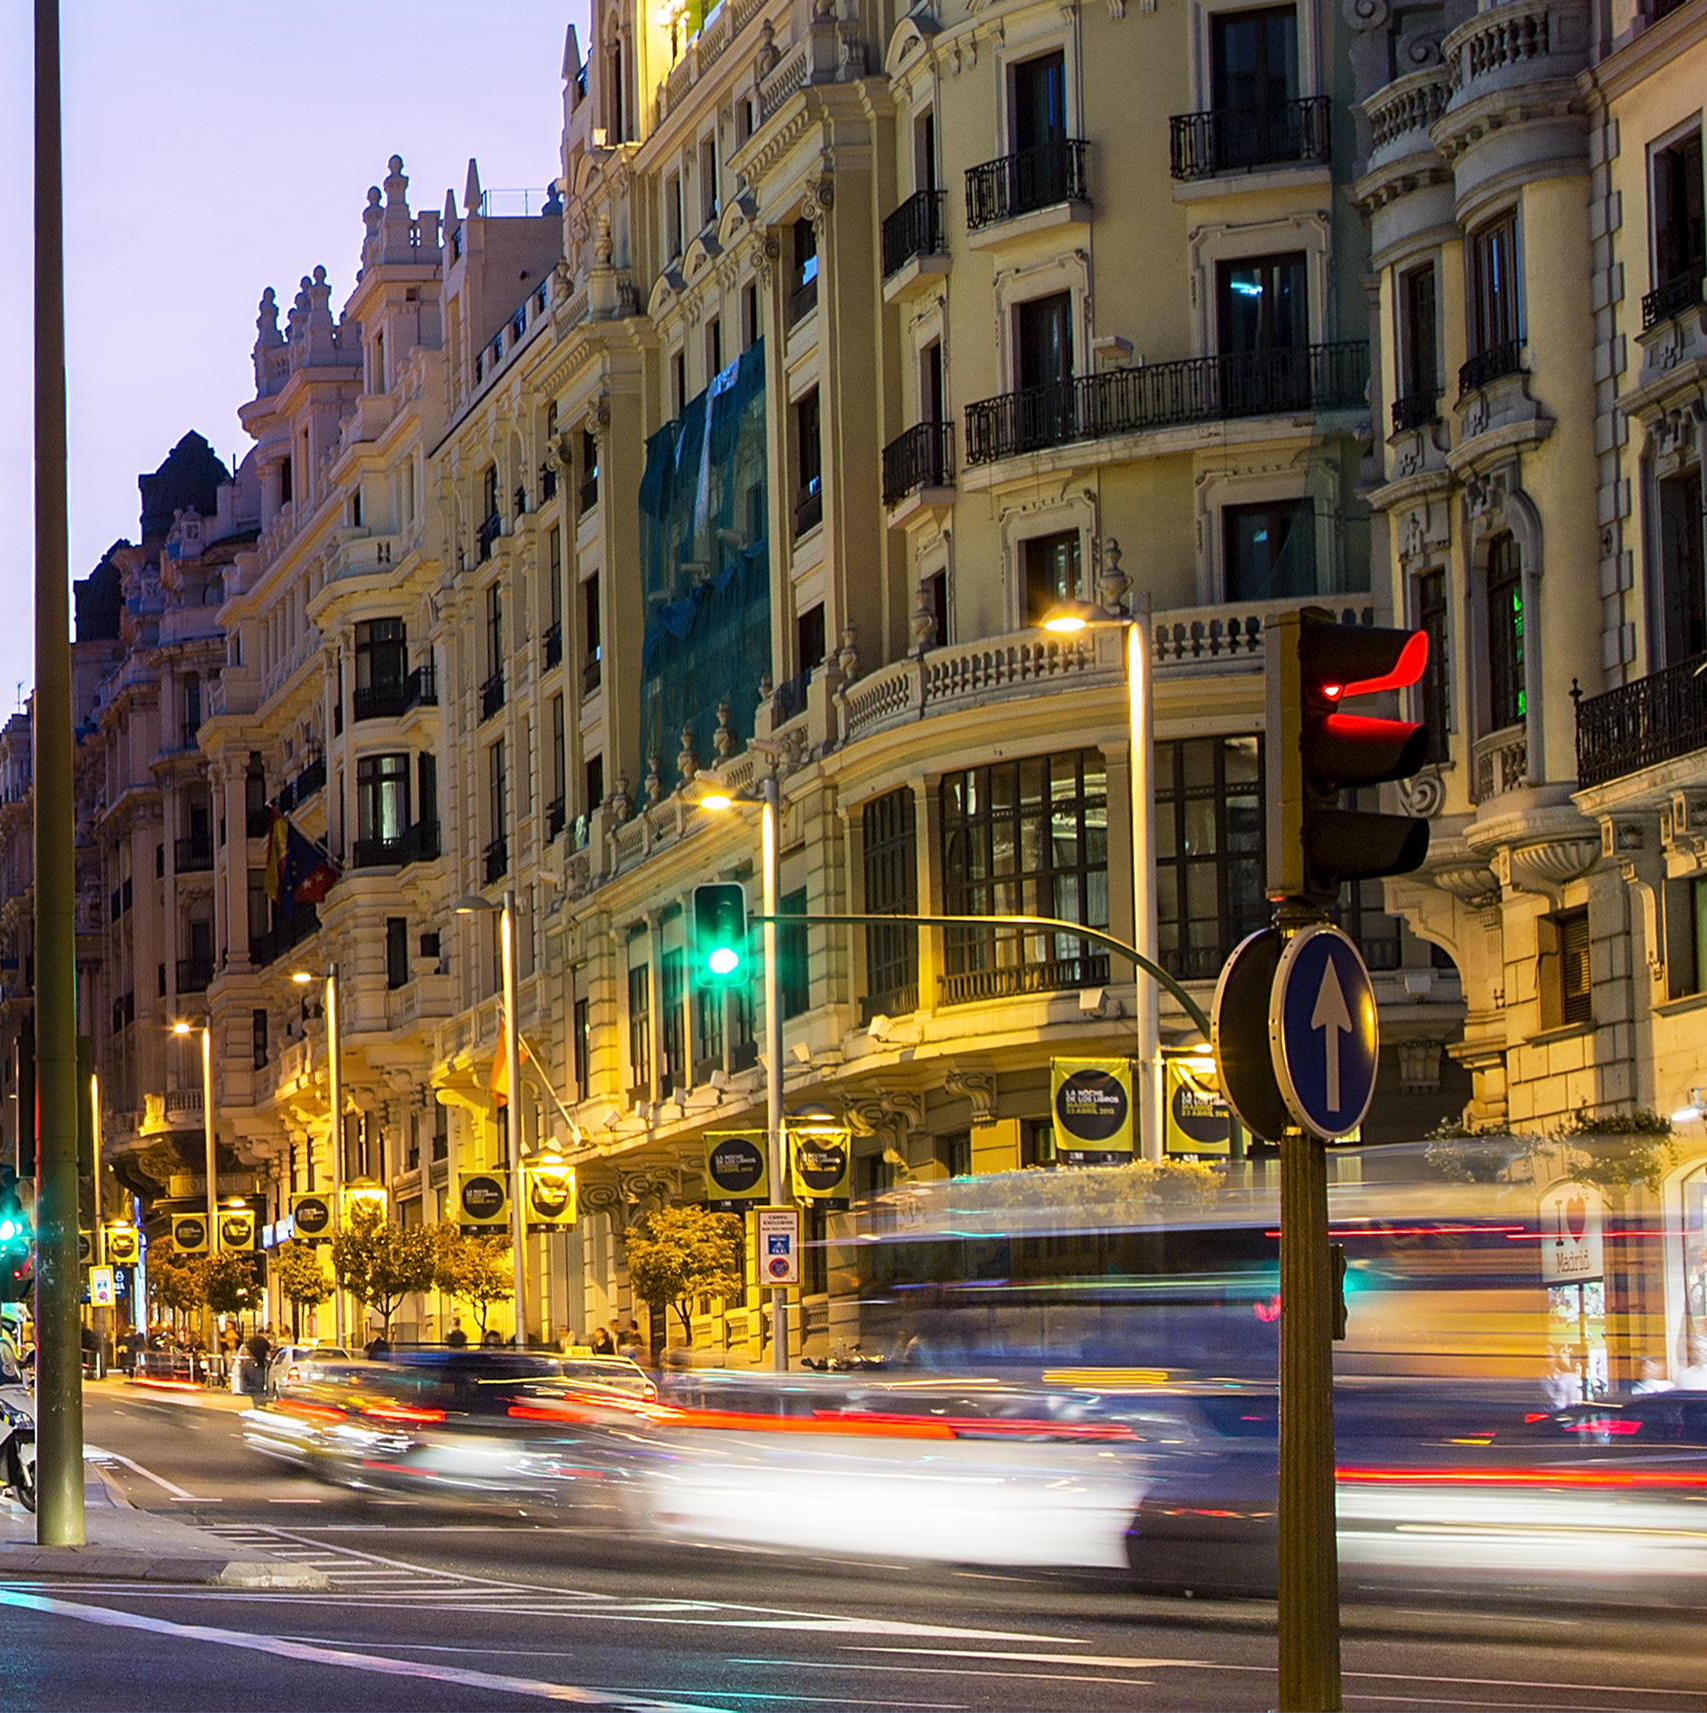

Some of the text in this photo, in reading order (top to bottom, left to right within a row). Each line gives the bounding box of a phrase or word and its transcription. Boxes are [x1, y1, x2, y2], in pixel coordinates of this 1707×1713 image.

[1077, 1089, 1103, 1097] NOCHE
[1181, 1091, 1220, 1100] LA NOCHE
[1093, 1095, 1120, 1103] LIBROS
[1555, 1199, 1564, 1246] I
[1556, 1249, 1590, 1269] Madrid
